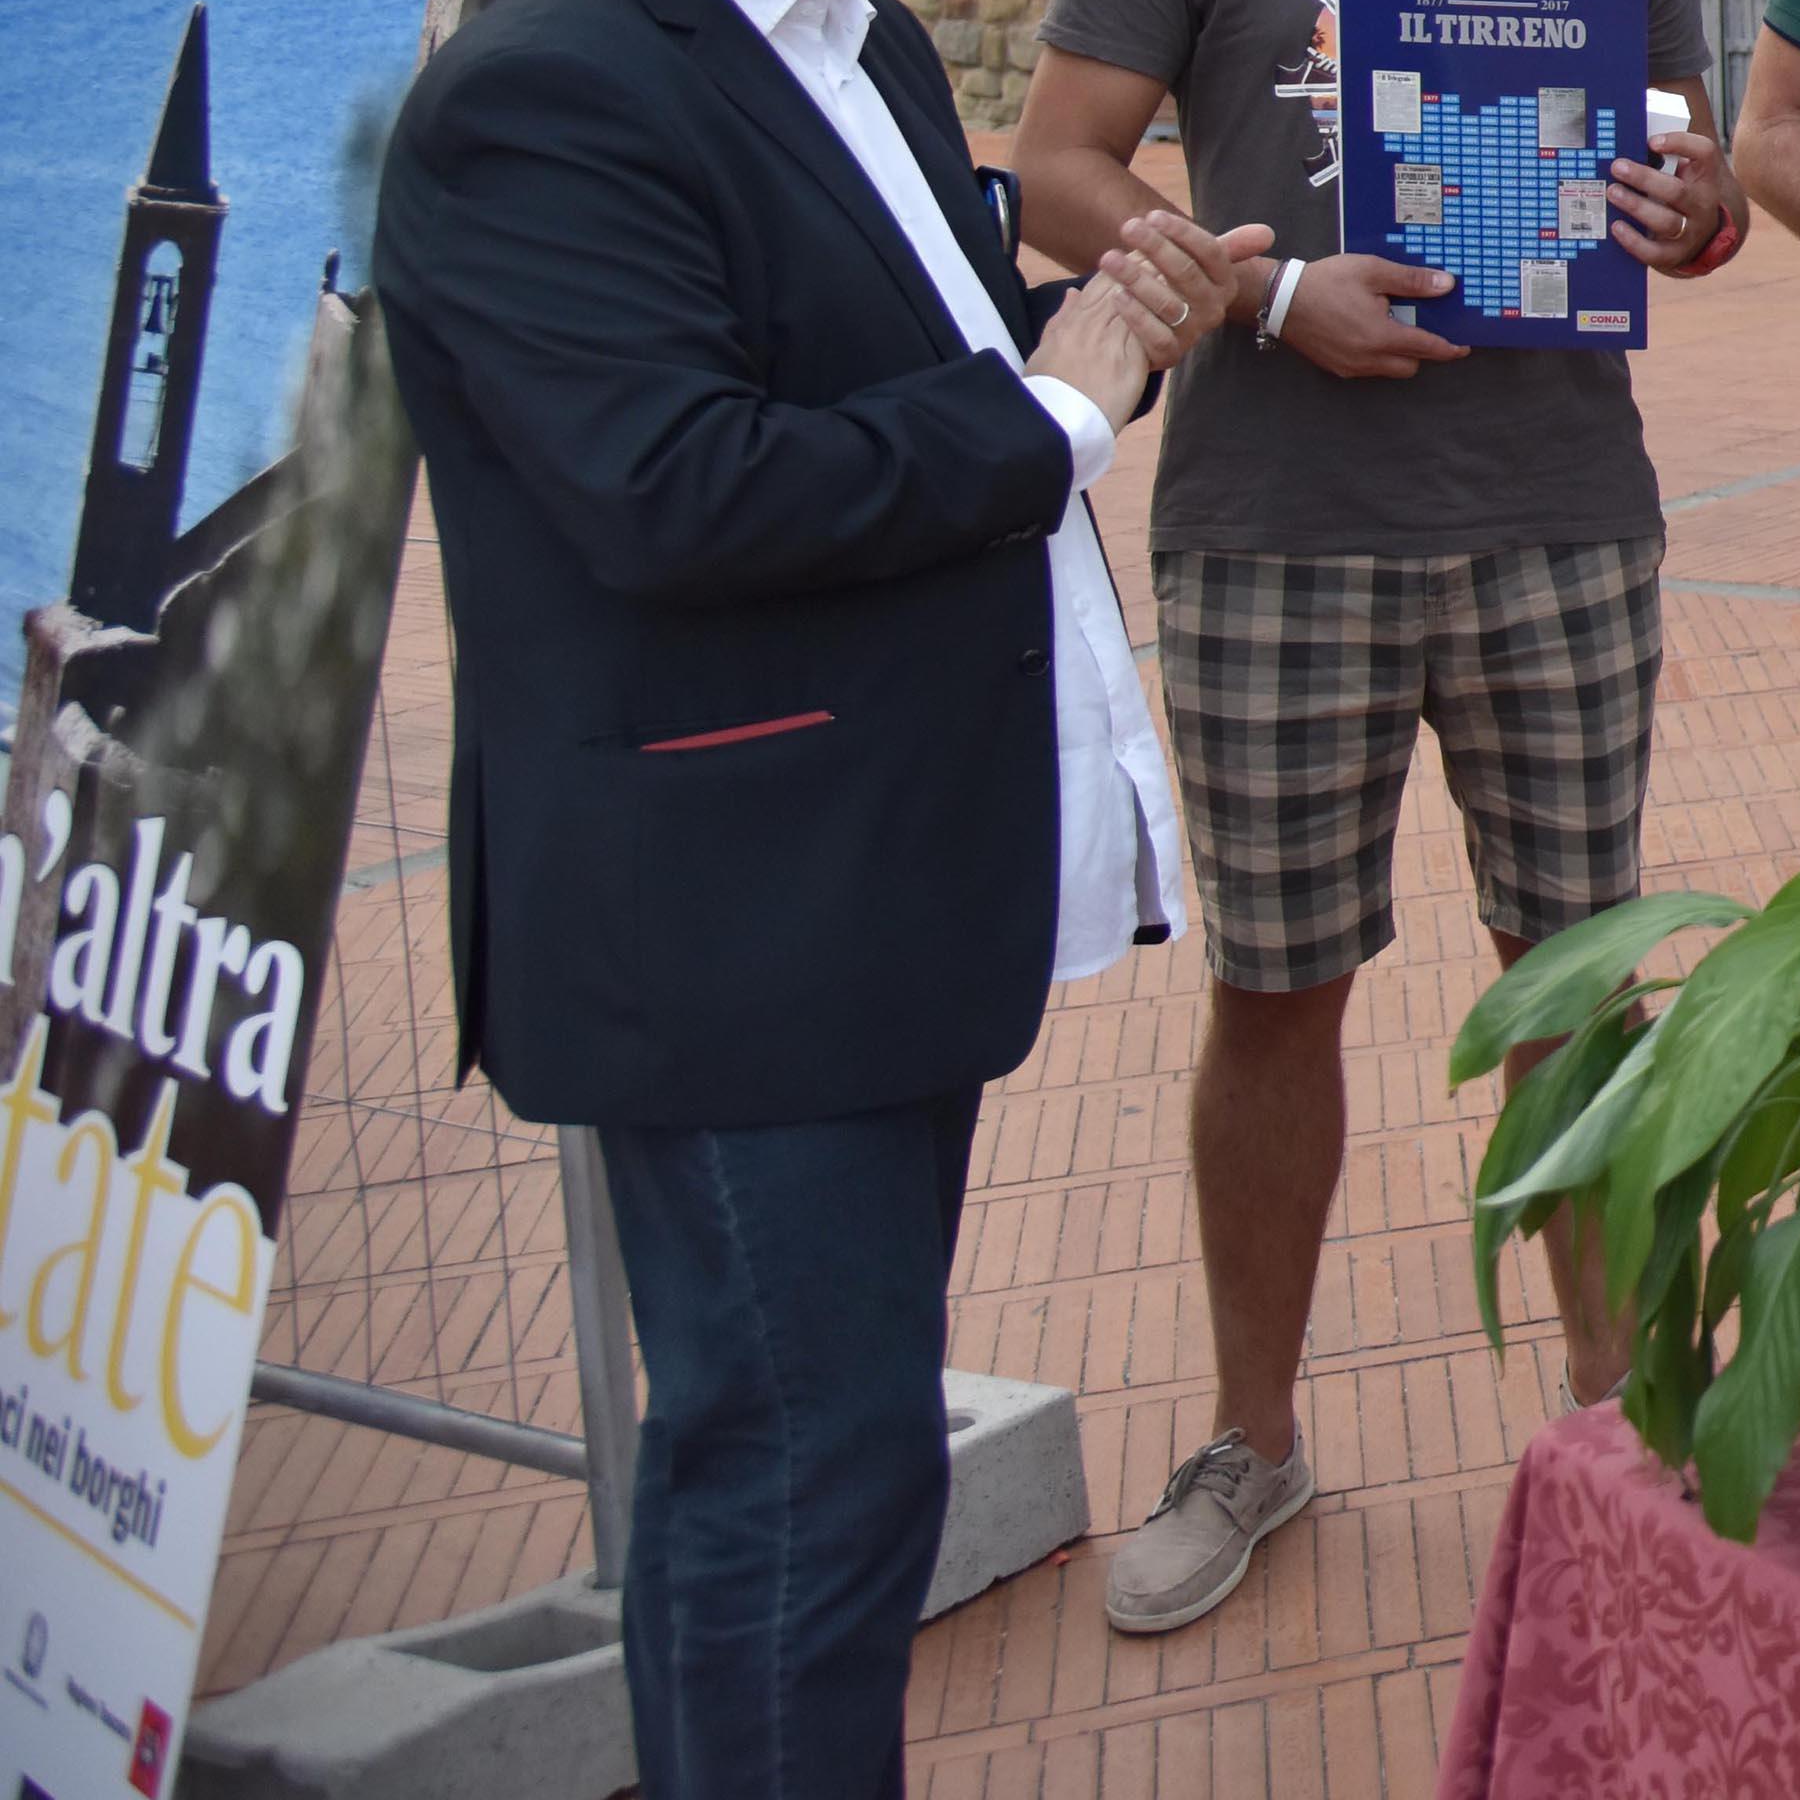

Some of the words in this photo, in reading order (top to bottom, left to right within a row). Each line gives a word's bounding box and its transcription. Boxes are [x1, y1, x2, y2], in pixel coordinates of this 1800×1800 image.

[1540, 0, 1570, 11] 2017
[1399, 12, 1432, 44] IL
[1435, 14, 1587, 50] TIRRENO
[1590, 315, 1628, 324] CONAD
[26, 1414, 72, 1481] nei
[70, 1427, 167, 1548] borghi
